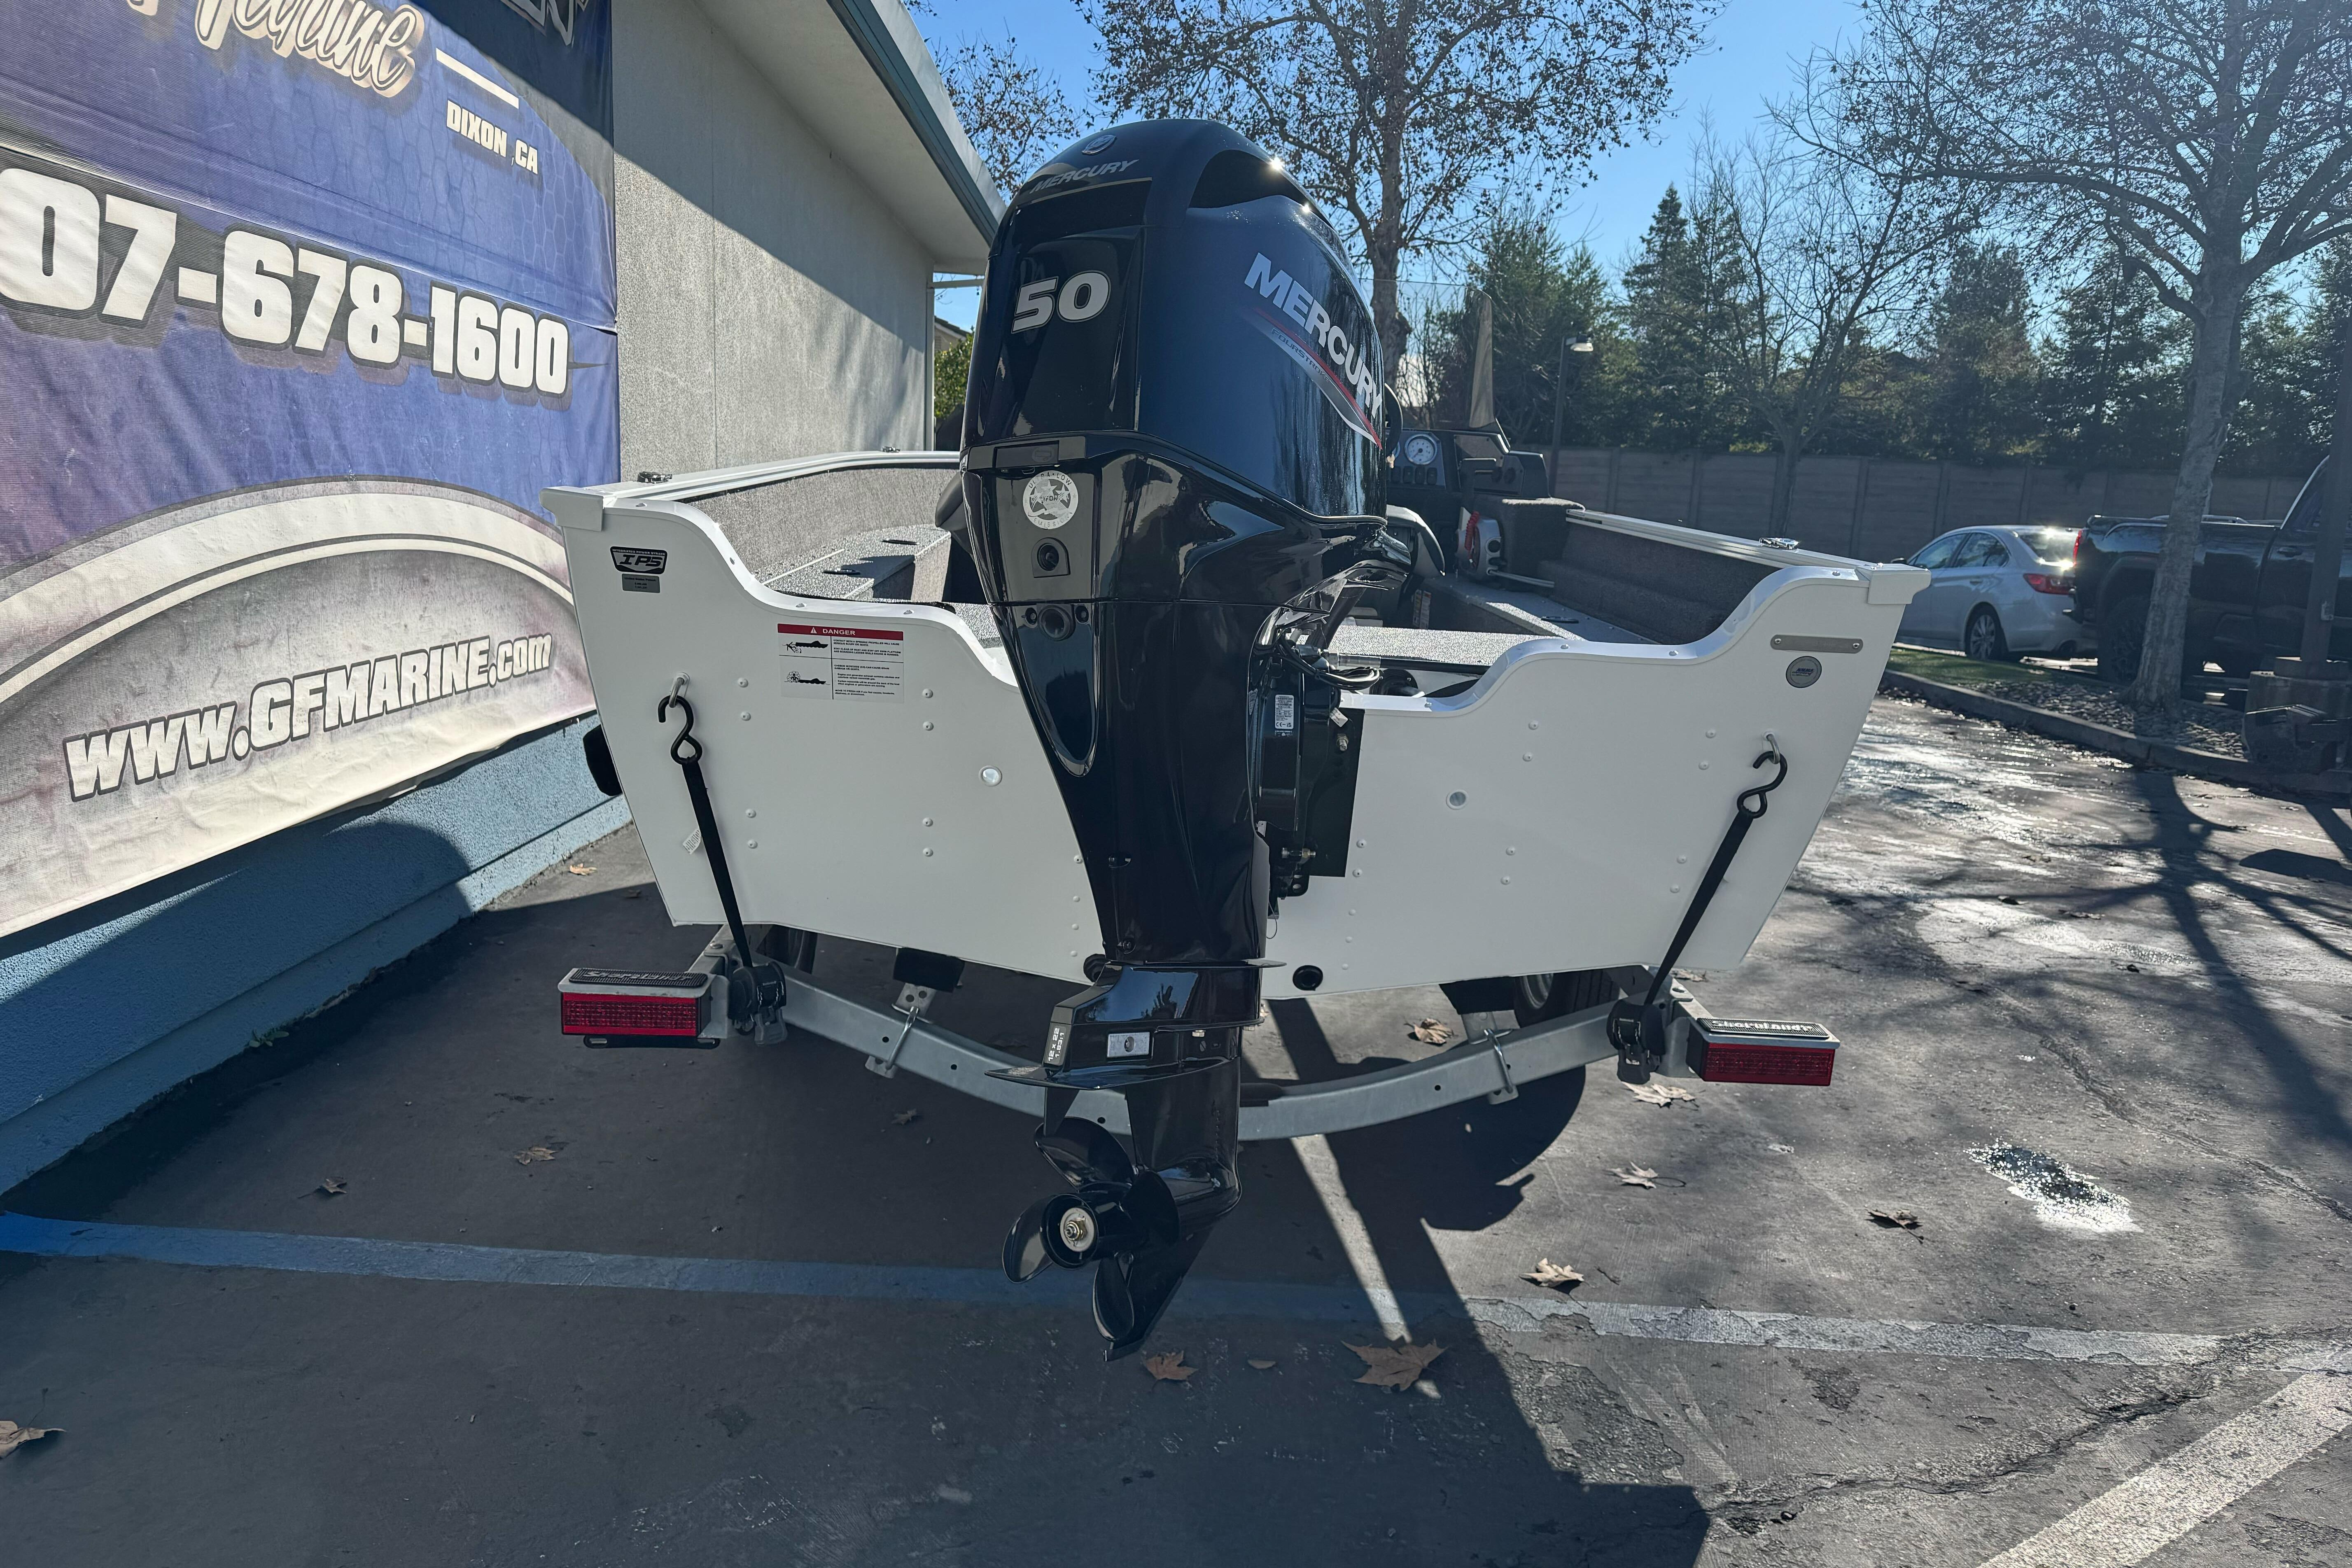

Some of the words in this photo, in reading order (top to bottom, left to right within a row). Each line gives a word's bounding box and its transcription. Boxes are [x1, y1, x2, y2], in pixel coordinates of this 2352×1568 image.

[1029, 159, 1140, 194] MERCURY
[1011, 270, 1111, 334] 50
[1244, 252, 1383, 419] MERCURY
[1271, 327, 1330, 383] FOURSTROKE
[1057, 472, 1071, 485] LOW
[619, 554, 663, 567] IPS
[1048, 1050, 1055, 1062] 12
[1052, 1028, 1060, 1041] 22
